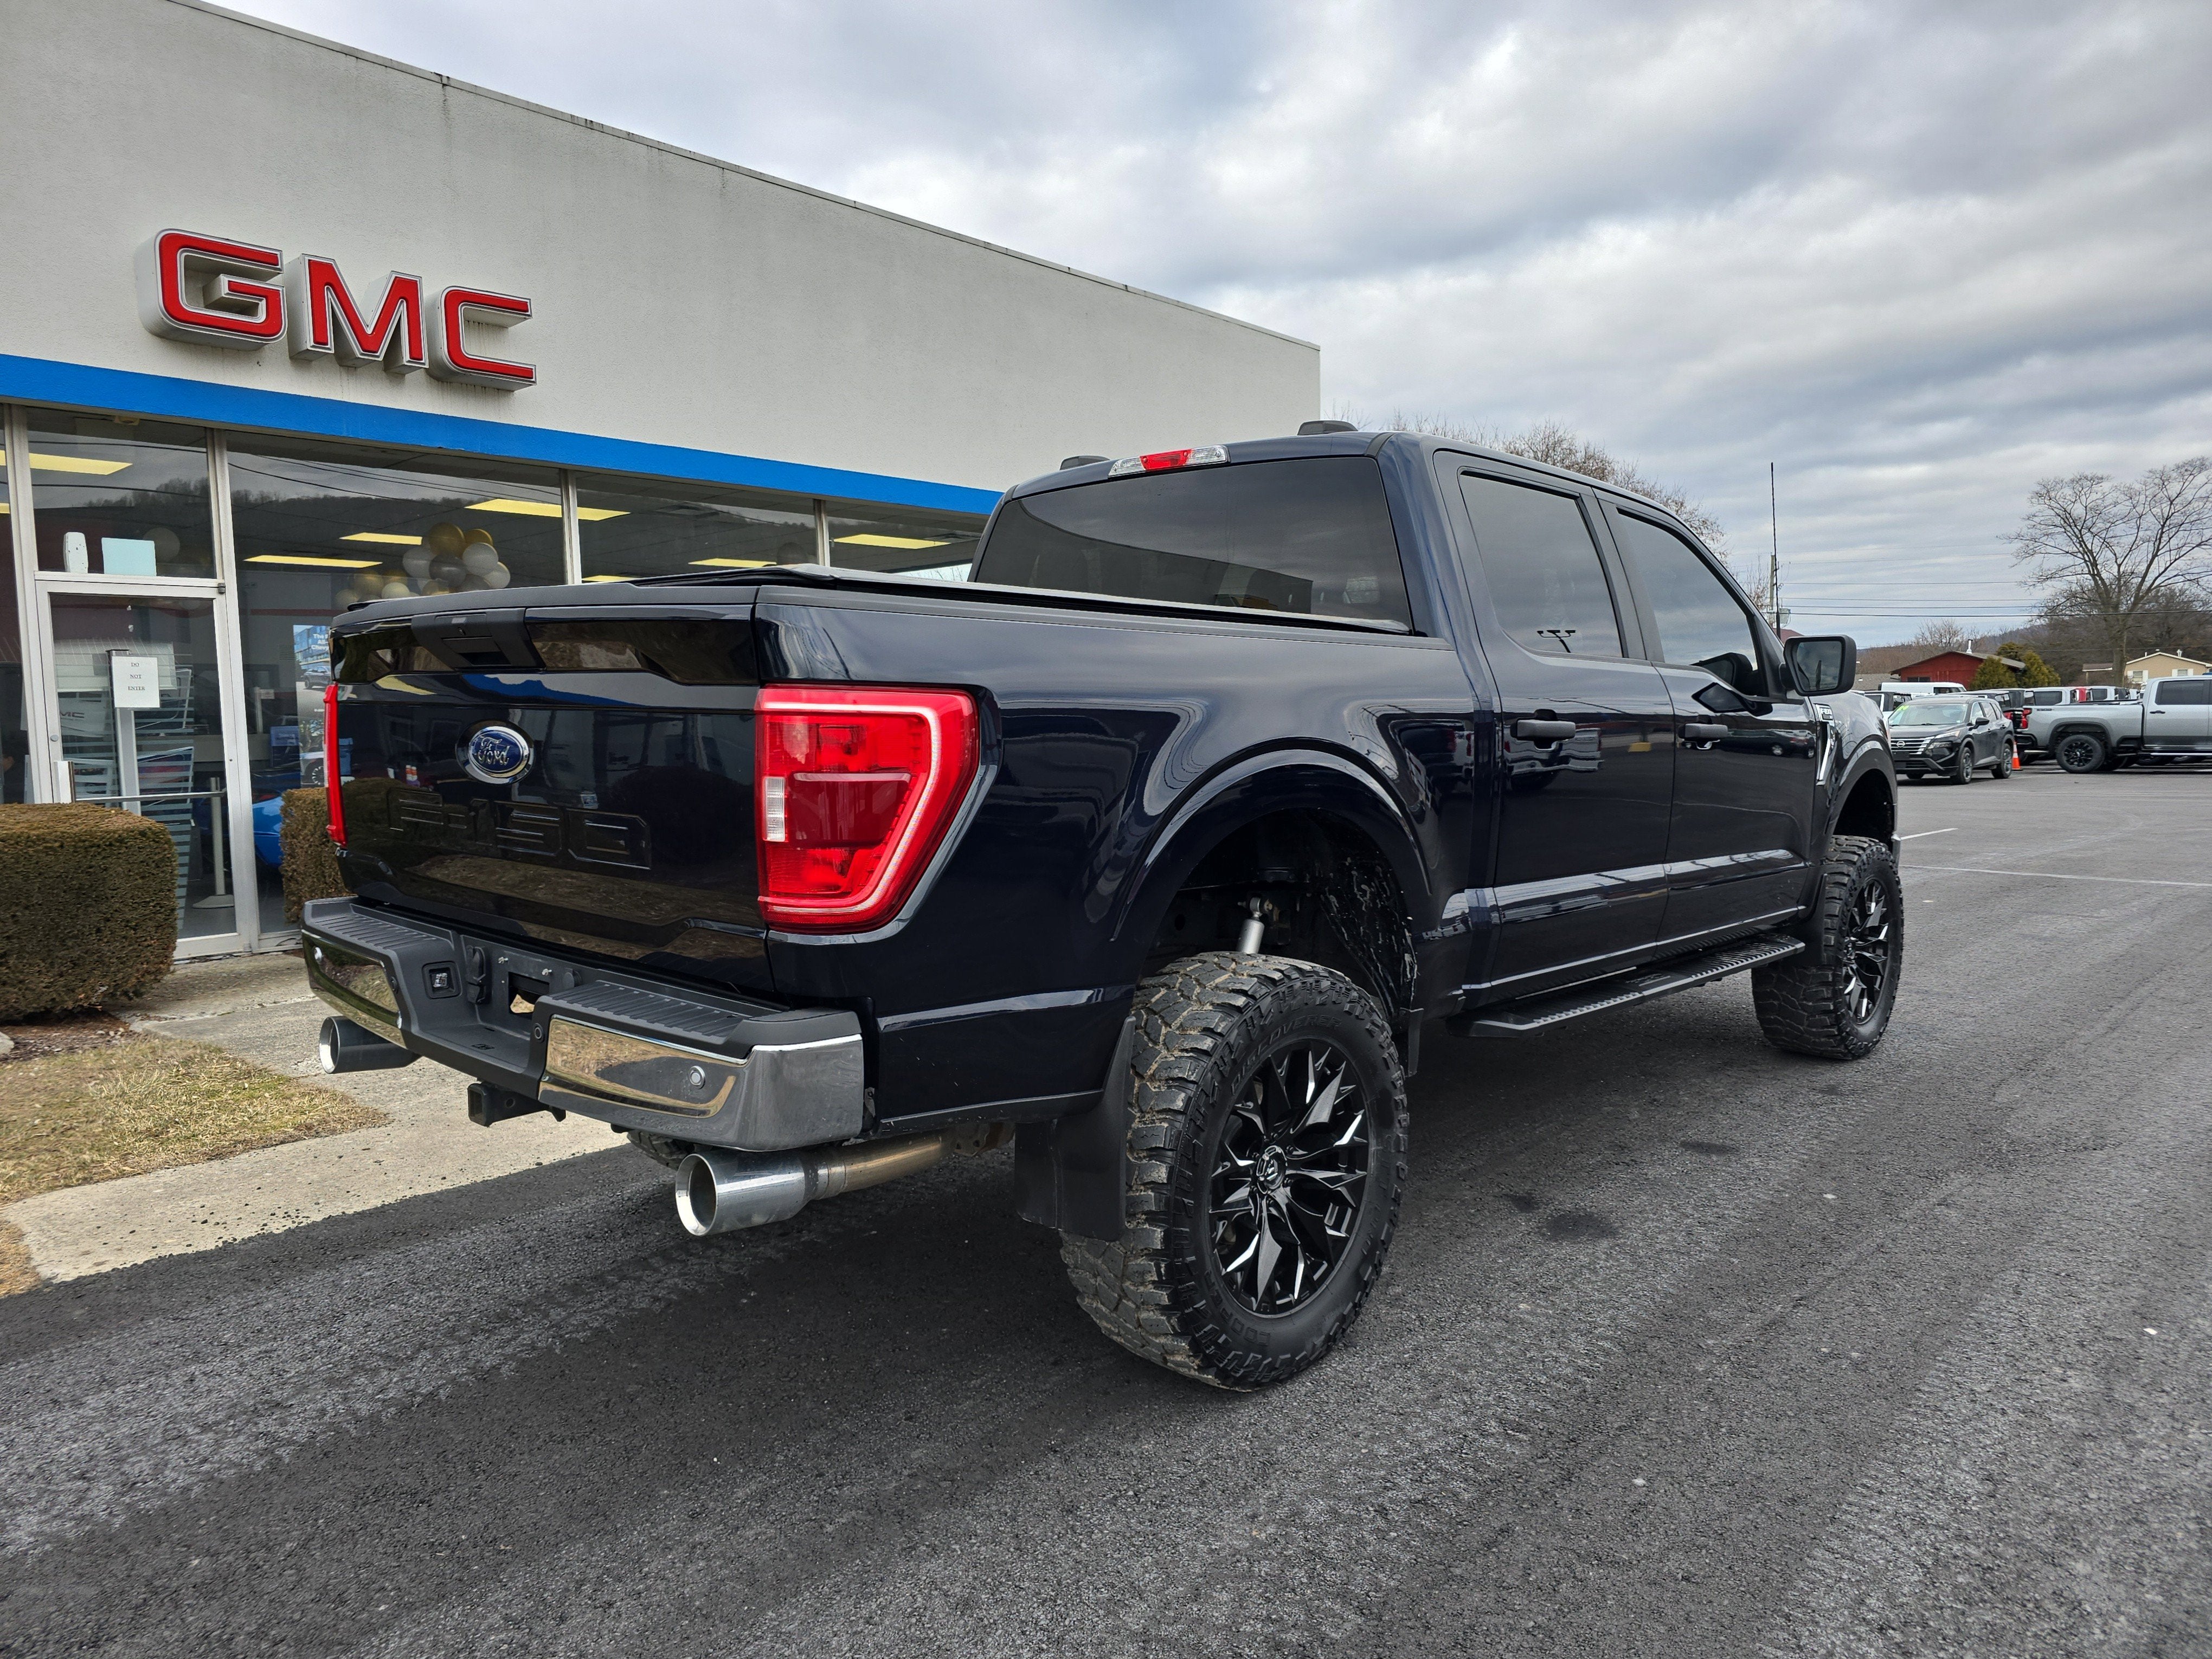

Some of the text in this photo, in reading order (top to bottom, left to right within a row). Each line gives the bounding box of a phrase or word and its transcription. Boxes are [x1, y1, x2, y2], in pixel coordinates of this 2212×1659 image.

[153, 228, 537, 386] GMC
[477, 735, 510, 766] Ford
[1231, 1013, 1342, 1096] DISCOVERER
